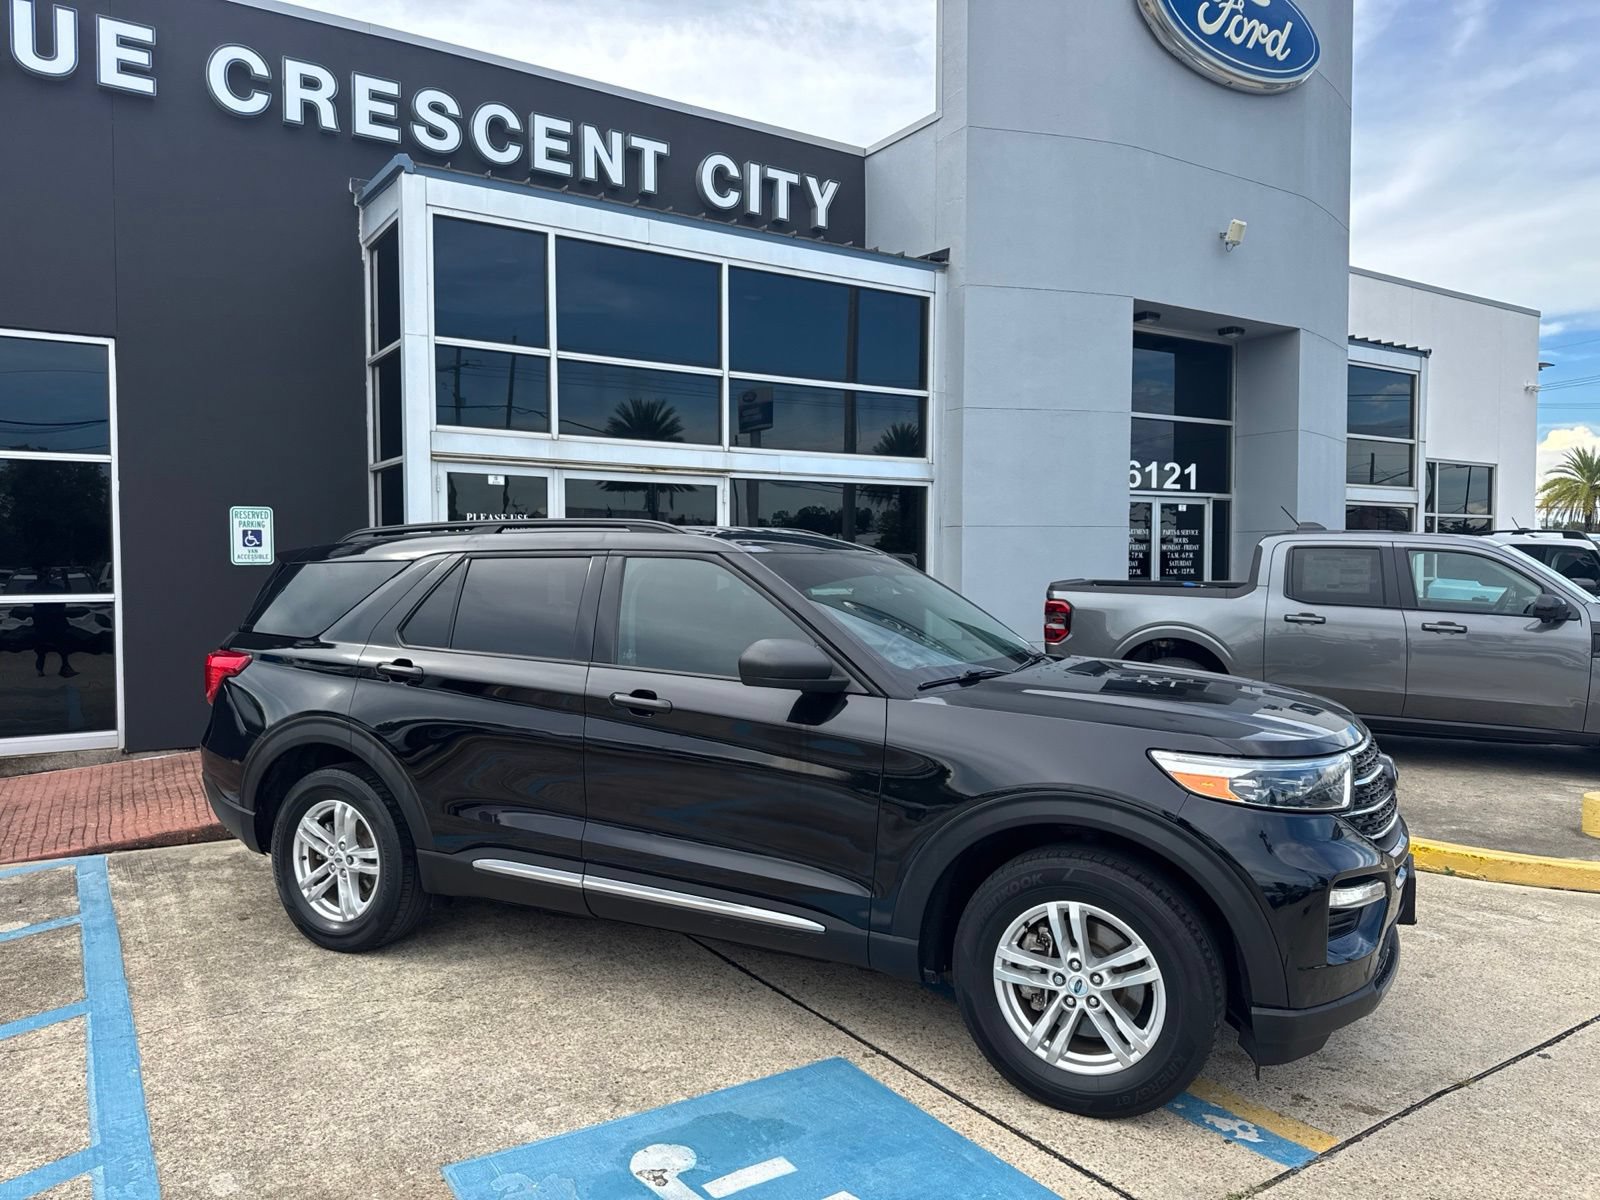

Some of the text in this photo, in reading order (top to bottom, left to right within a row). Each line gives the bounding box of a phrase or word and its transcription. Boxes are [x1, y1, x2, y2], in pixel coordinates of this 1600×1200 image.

[1197, 0, 1293, 61] Ford
[205, 43, 670, 195] CRESCENT
[696, 151, 841, 230] CITY
[1129, 460, 1197, 490] 6121
[234, 510, 269, 520] RESERVED
[238, 520, 266, 529] PARKING
[466, 512, 508, 521] PLEASE
